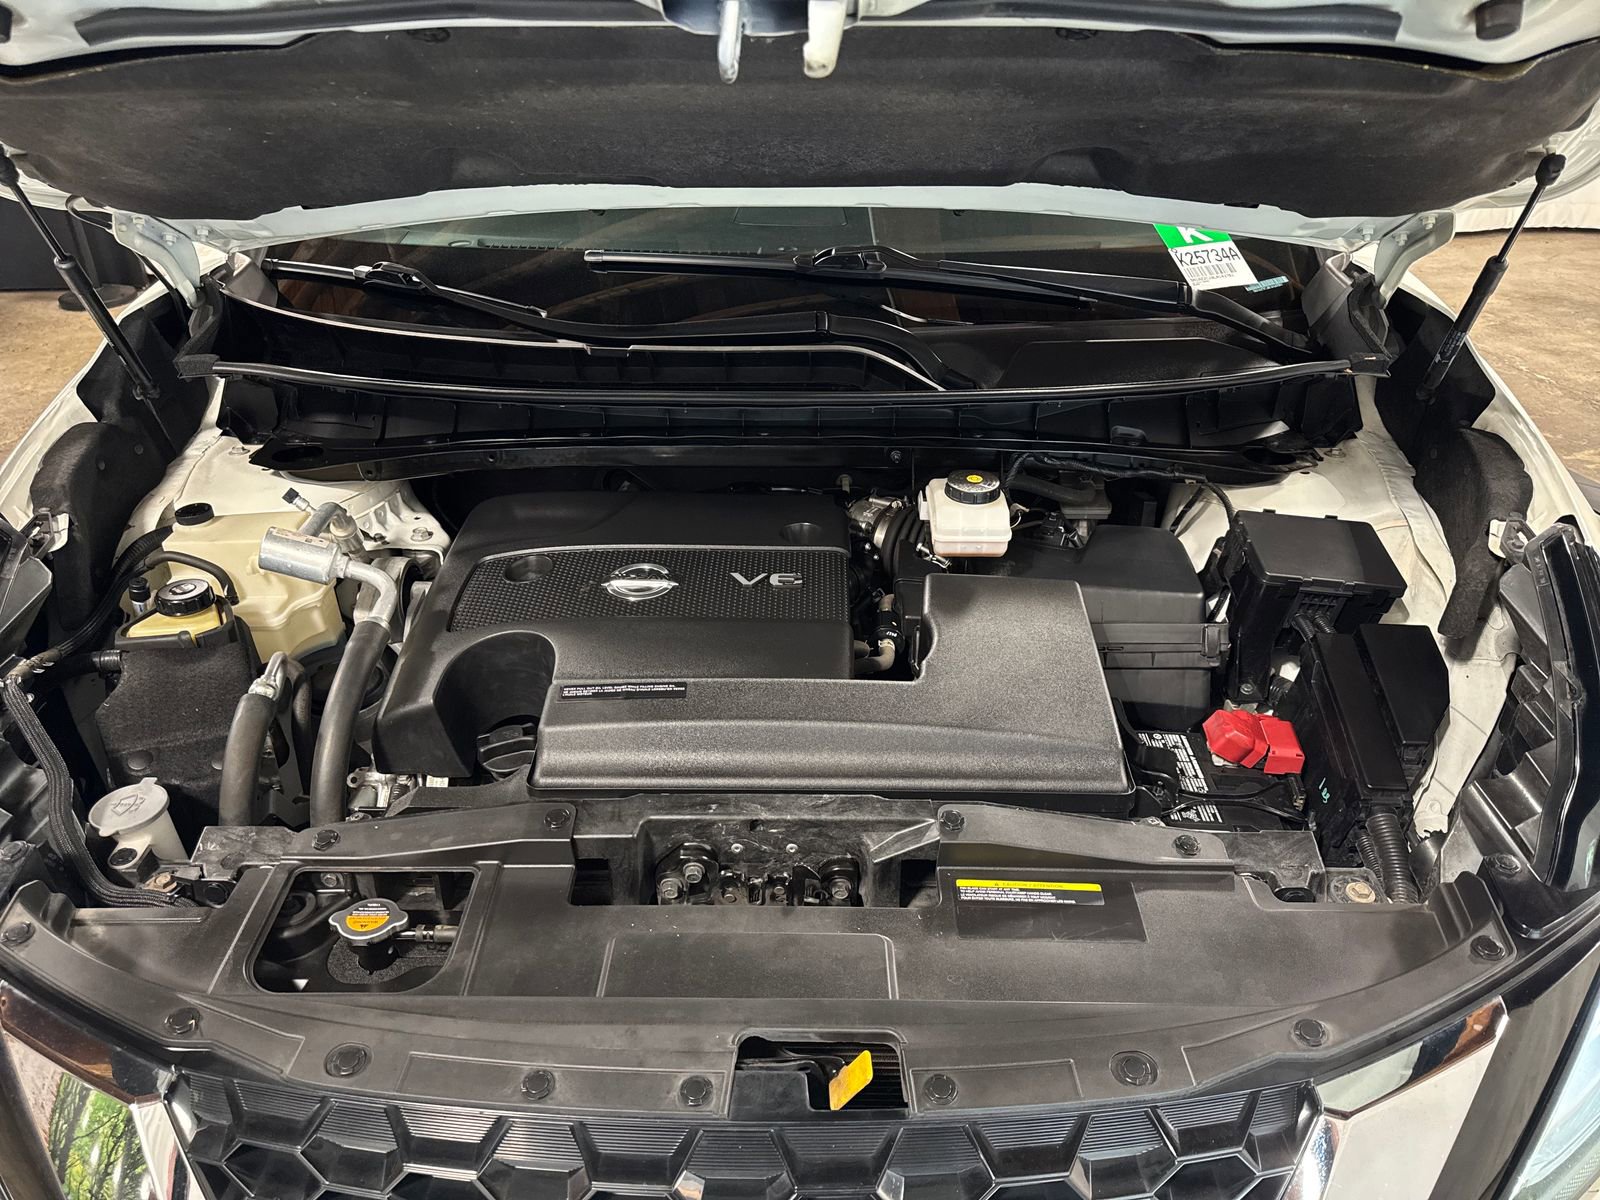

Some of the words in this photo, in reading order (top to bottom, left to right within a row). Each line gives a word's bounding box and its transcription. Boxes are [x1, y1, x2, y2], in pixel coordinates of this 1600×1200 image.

[1176, 226, 1214, 243] K
[1175, 247, 1241, 267] K25734A
[730, 572, 803, 587] V6
